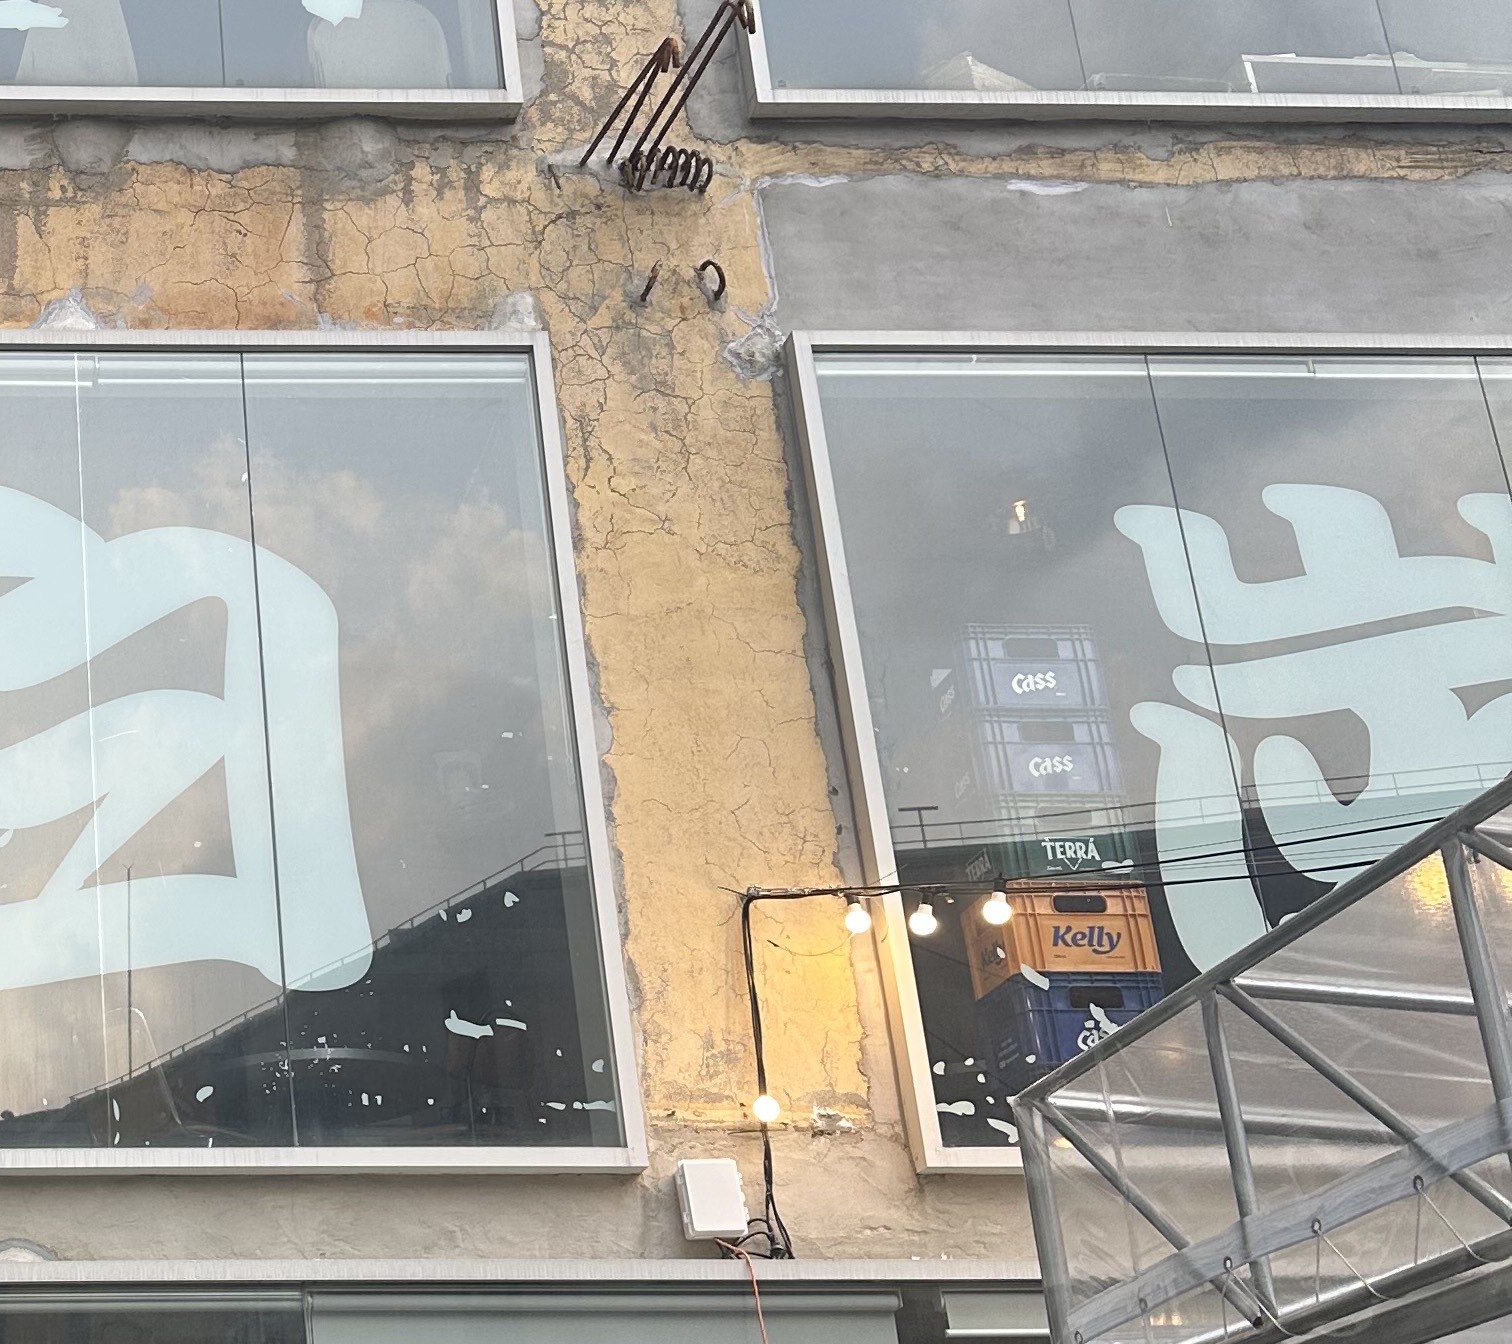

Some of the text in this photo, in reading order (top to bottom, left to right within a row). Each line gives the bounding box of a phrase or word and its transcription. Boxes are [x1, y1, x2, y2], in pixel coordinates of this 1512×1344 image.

[1011, 671, 1057, 695] Cass
[1028, 755, 1074, 778] Cass
[1041, 837, 1102, 861] TERRA
[1052, 925, 1122, 955] Kelly
